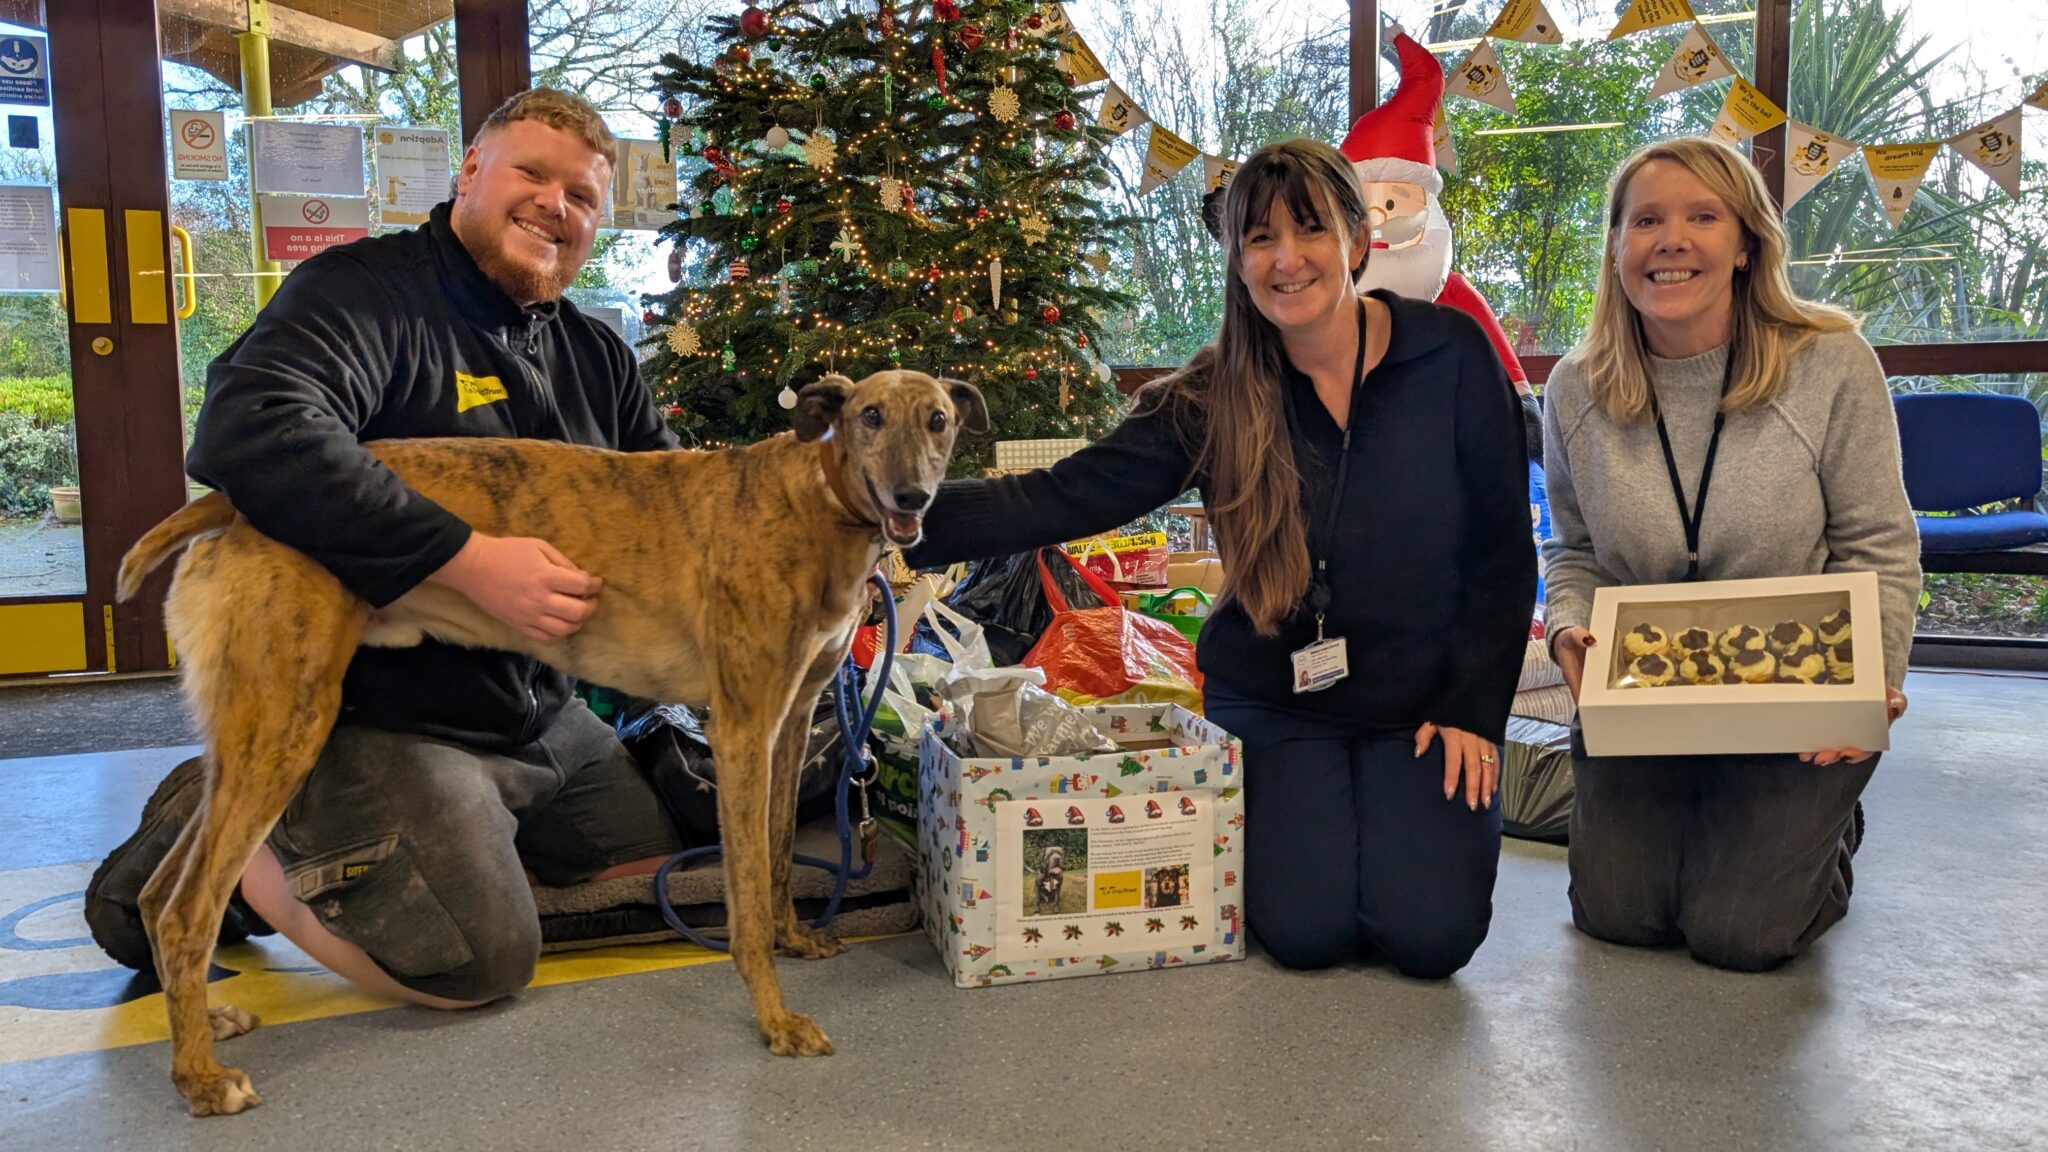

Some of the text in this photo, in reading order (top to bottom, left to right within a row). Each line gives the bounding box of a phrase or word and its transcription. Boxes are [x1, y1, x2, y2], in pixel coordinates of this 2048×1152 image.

[1884, 148, 1924, 161] dream big
[1024, 718, 1048, 746] We
